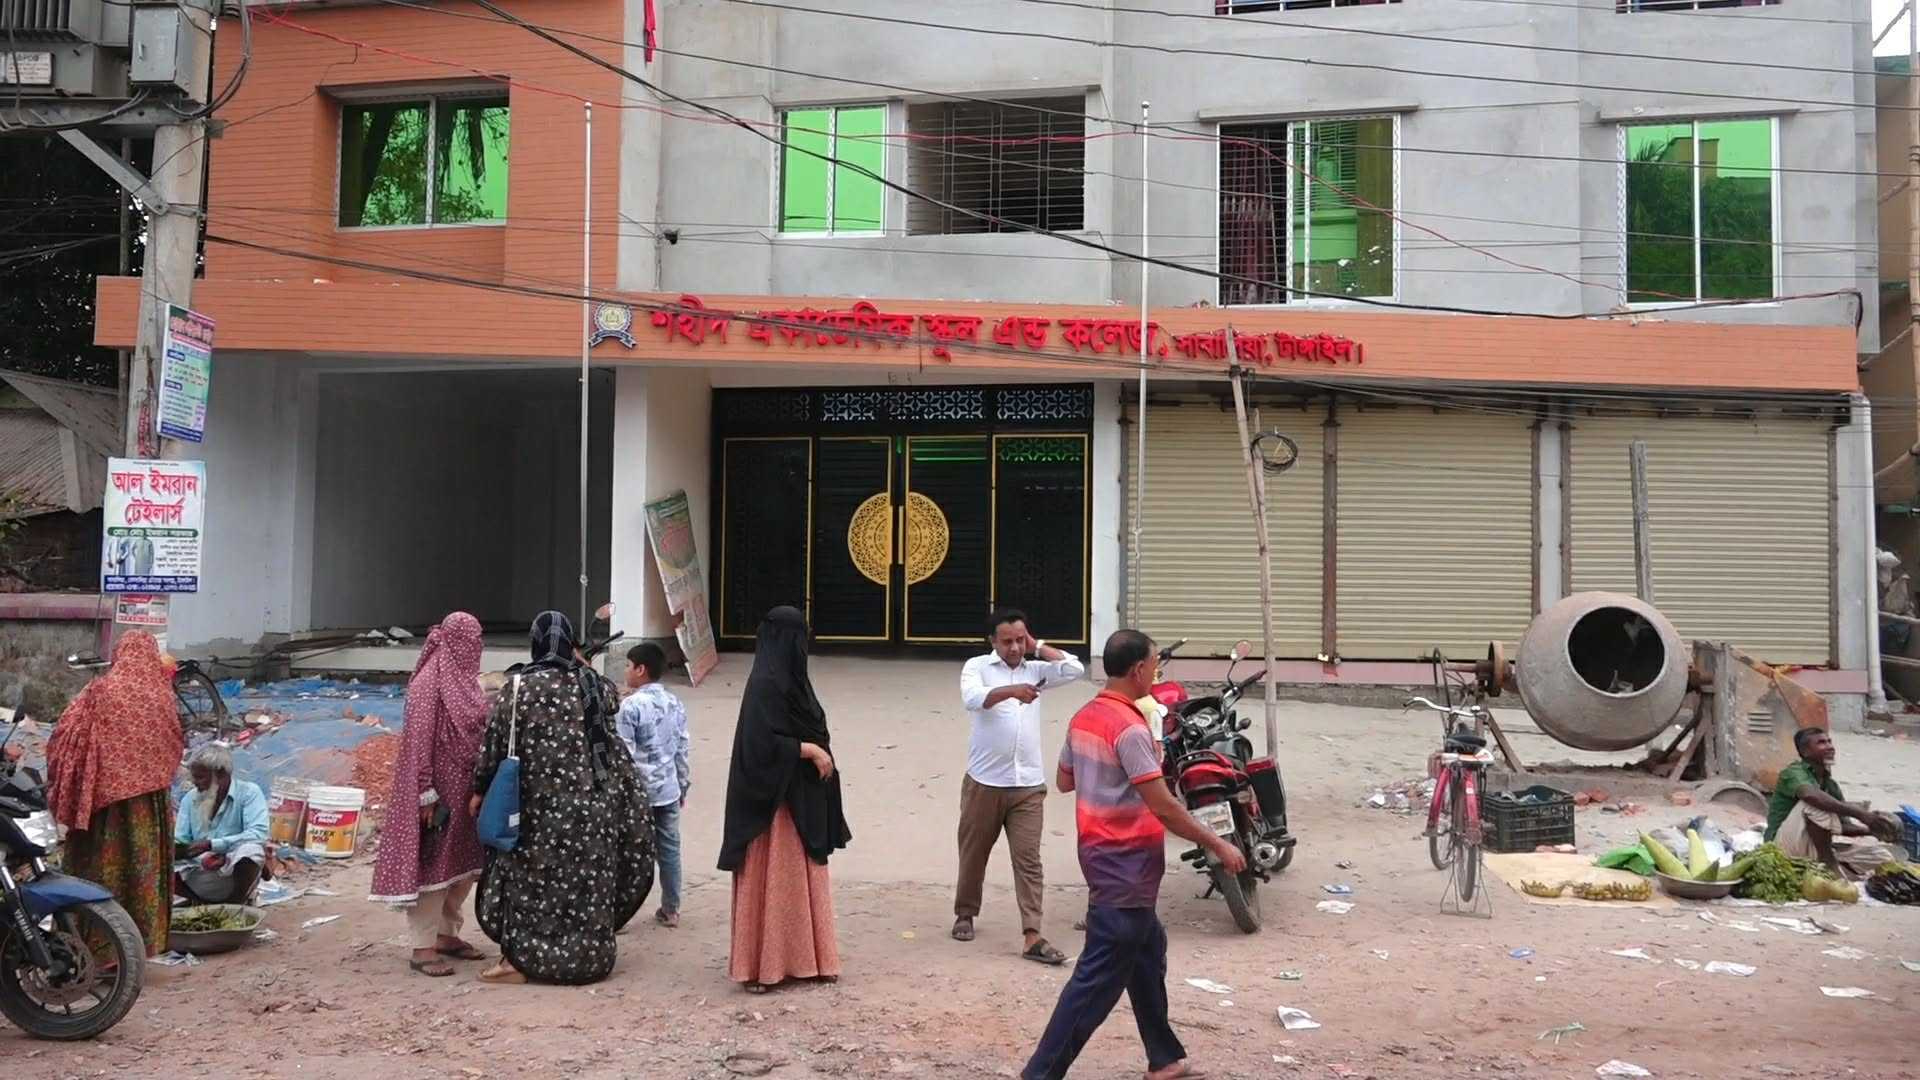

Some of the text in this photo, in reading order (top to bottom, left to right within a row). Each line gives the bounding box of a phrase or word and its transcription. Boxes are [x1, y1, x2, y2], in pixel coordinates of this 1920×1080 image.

[921, 315, 983, 362] স্কুল
[111, 467, 199, 496] আল ইমরান
[125, 496, 185, 526] টেইলার্স
